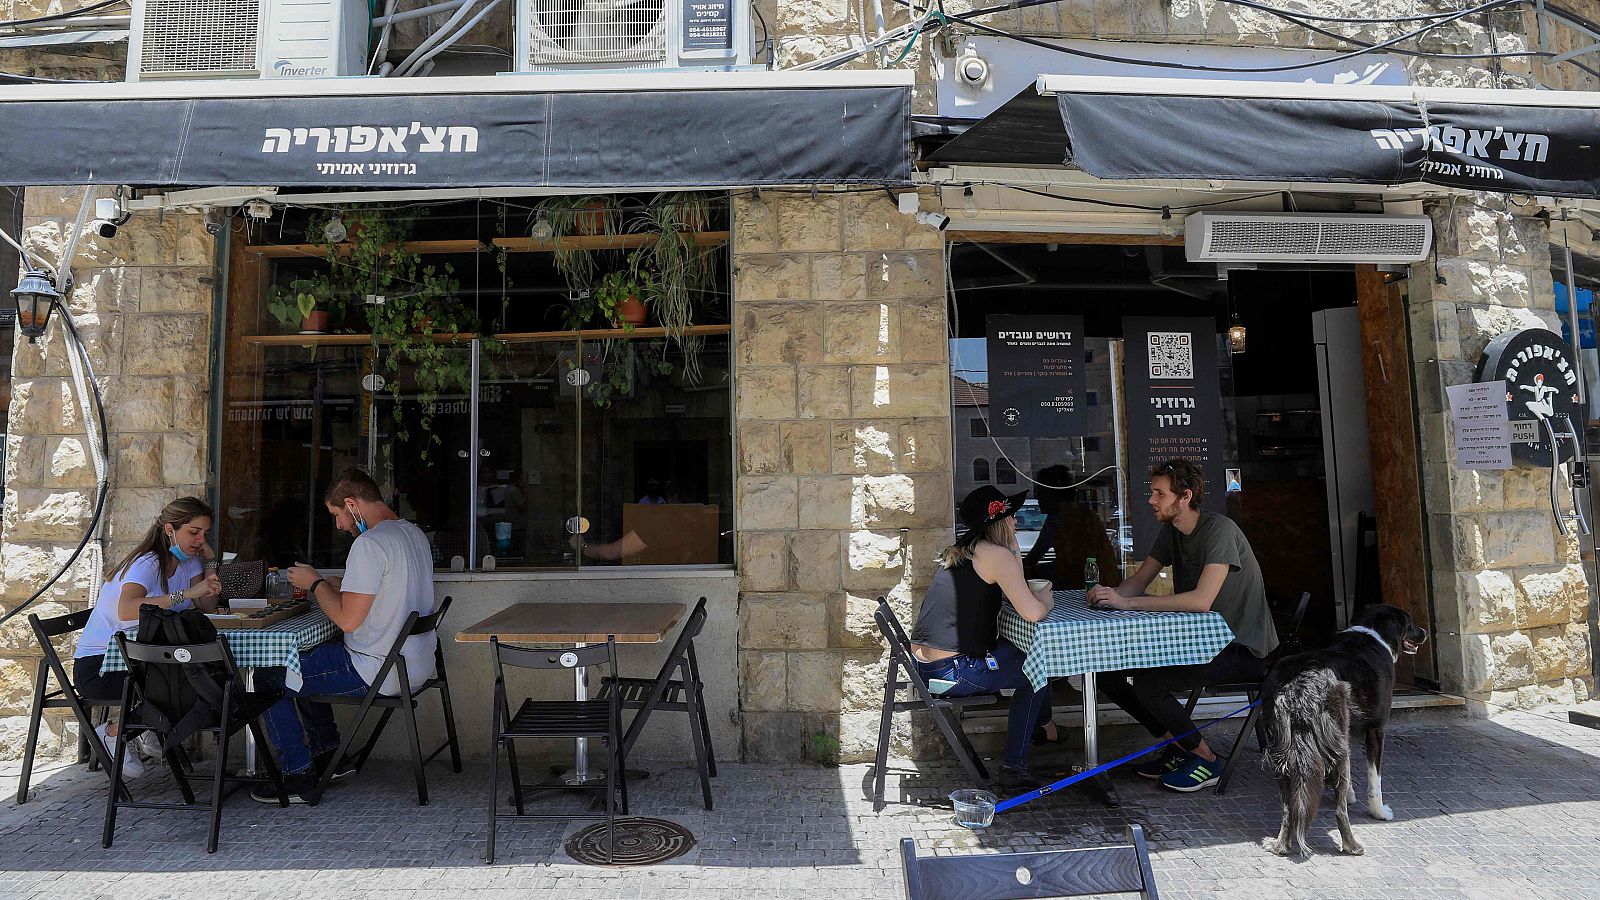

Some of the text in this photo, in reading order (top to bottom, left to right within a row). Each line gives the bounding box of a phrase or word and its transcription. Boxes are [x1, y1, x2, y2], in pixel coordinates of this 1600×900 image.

[280, 65, 327, 76] Inverter
[316, 162, 417, 175] גרוזיני אמיתי
[1465, 164, 1504, 181] גרוזיני
[998, 331, 1072, 340] דרושים עובדים
[1150, 396, 1196, 409] גרוזיני
[1155, 412, 1191, 428] לדרך
[1513, 423, 1532, 431] דחוף
[1513, 432, 1535, 440] PUSH
